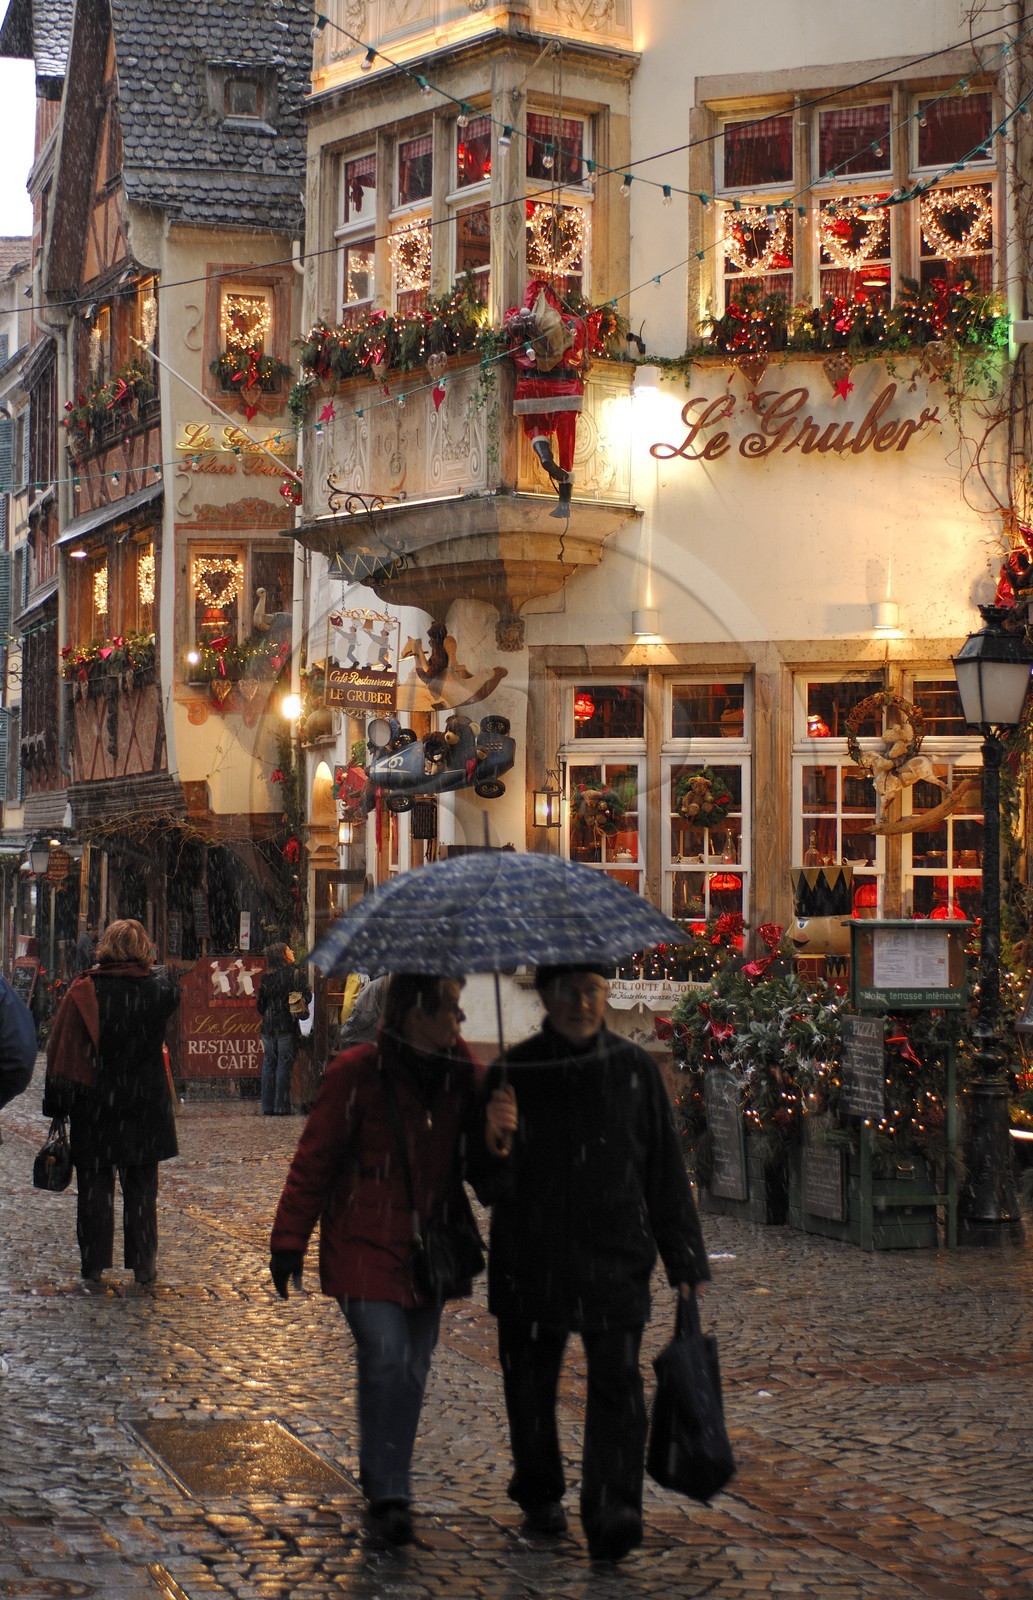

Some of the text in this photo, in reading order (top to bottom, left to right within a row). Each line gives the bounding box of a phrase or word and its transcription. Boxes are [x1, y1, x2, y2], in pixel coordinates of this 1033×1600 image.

[649, 382, 940, 460] Le Gruber
[177, 423, 216, 449] Le
[330, 688, 393, 705] LE GRUBER
[629, 982, 660, 992] TOUTE
[662, 981, 672, 991] LA
[889, 991, 923, 1000] terrasse
[193, 1014, 218, 1034] Le
[852, 1020, 878, 1038] PIZZA
[187, 1039, 265, 1055] RESTAURA
[217, 1054, 259, 1069] CAFÉ
